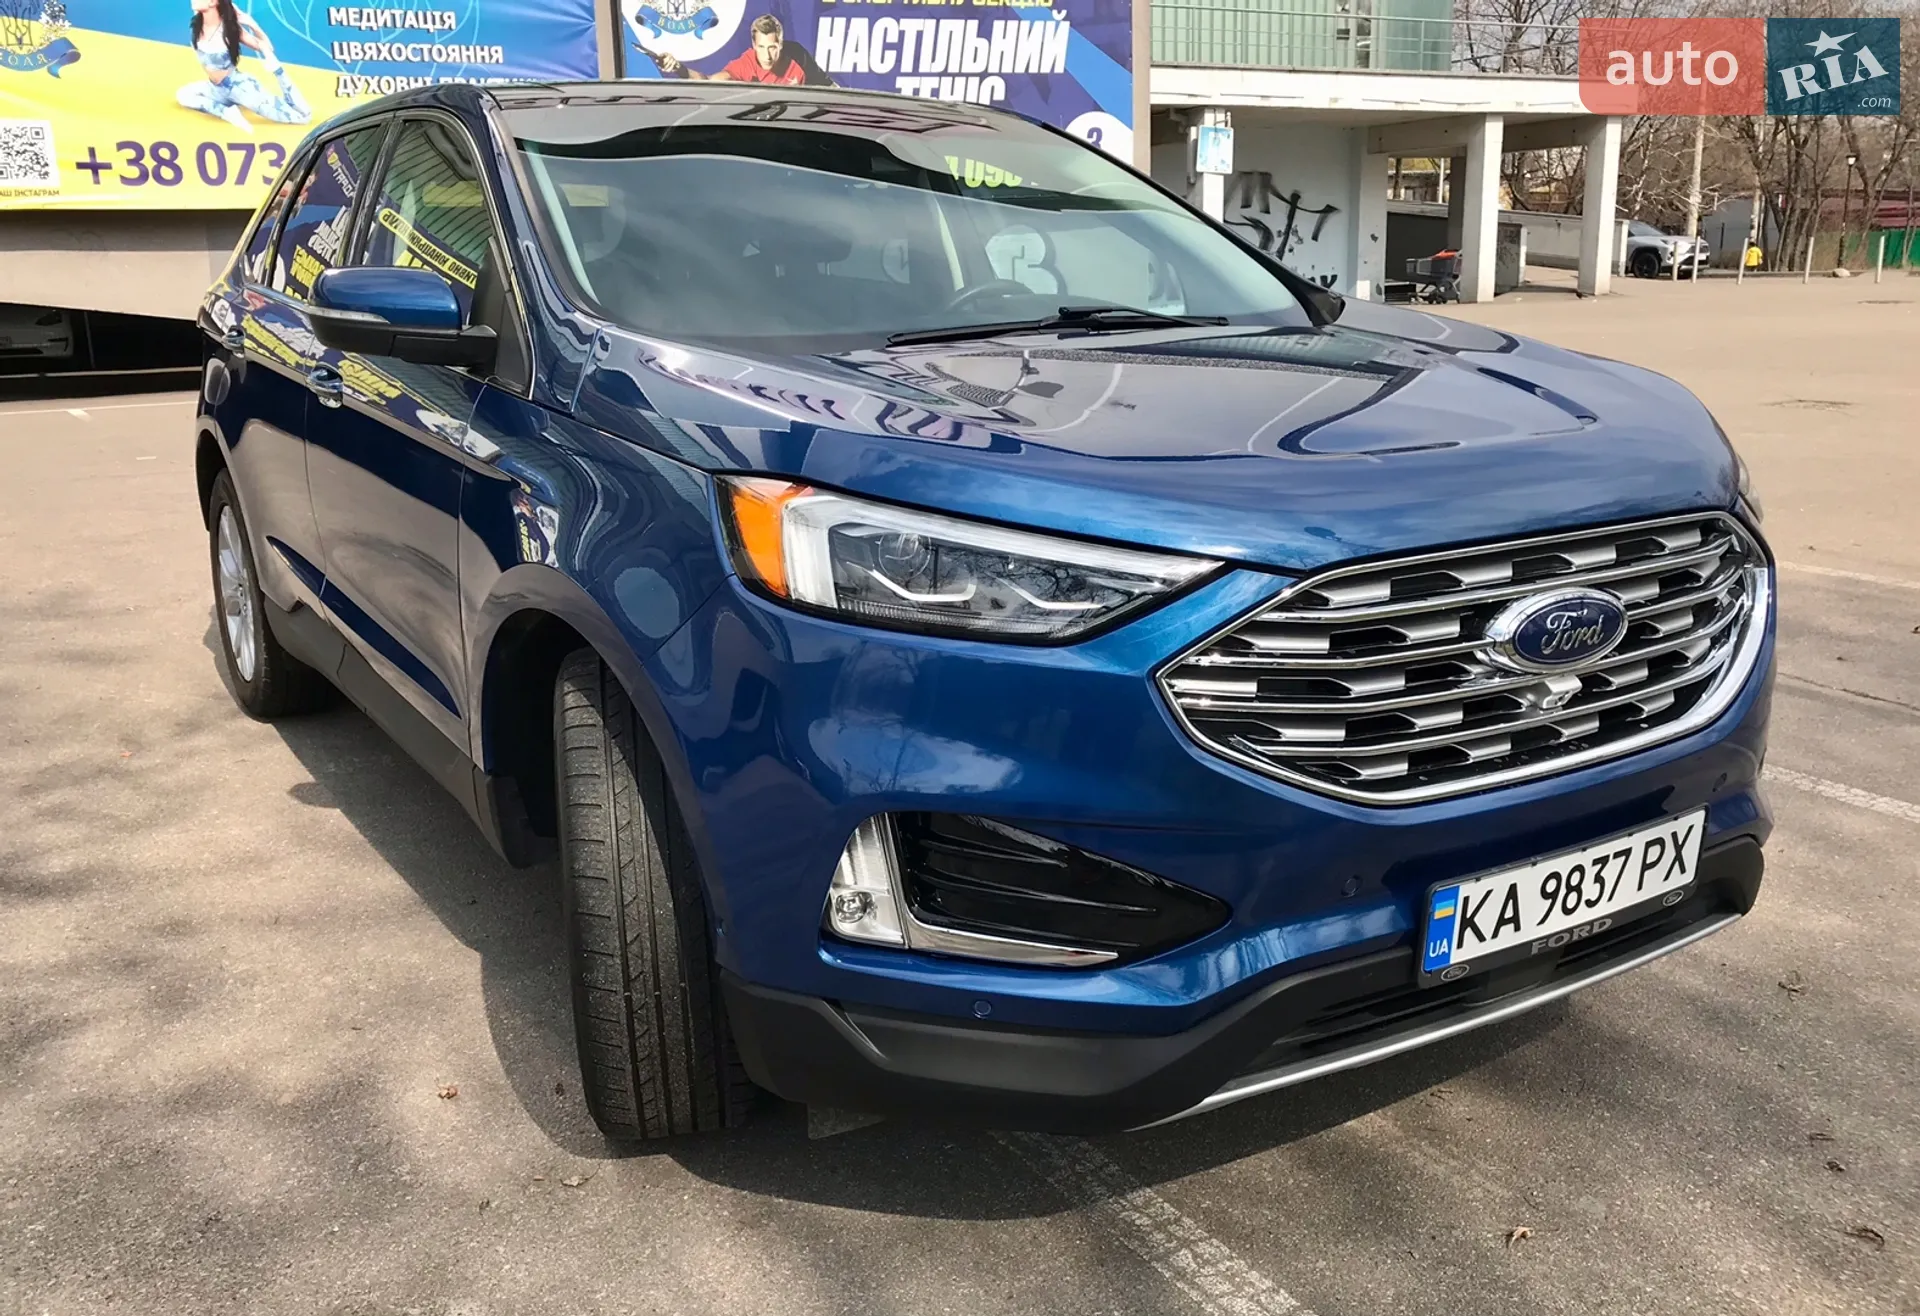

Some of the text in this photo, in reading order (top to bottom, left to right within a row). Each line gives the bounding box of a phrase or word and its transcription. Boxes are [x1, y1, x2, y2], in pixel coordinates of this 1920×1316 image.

[328, 7, 456, 32] МЕДИТАЦІЯ
[815, 9, 1071, 74] НАСТІЛЬНИЙ
[331, 41, 504, 64] ЦВЯХОСТОЯННЯ
[76, 140, 183, 186] +38
[1541, 609, 1603, 654] Ford
[1429, 824, 1695, 958] UA KA 9837 PX
[1530, 918, 1612, 955] FORD
